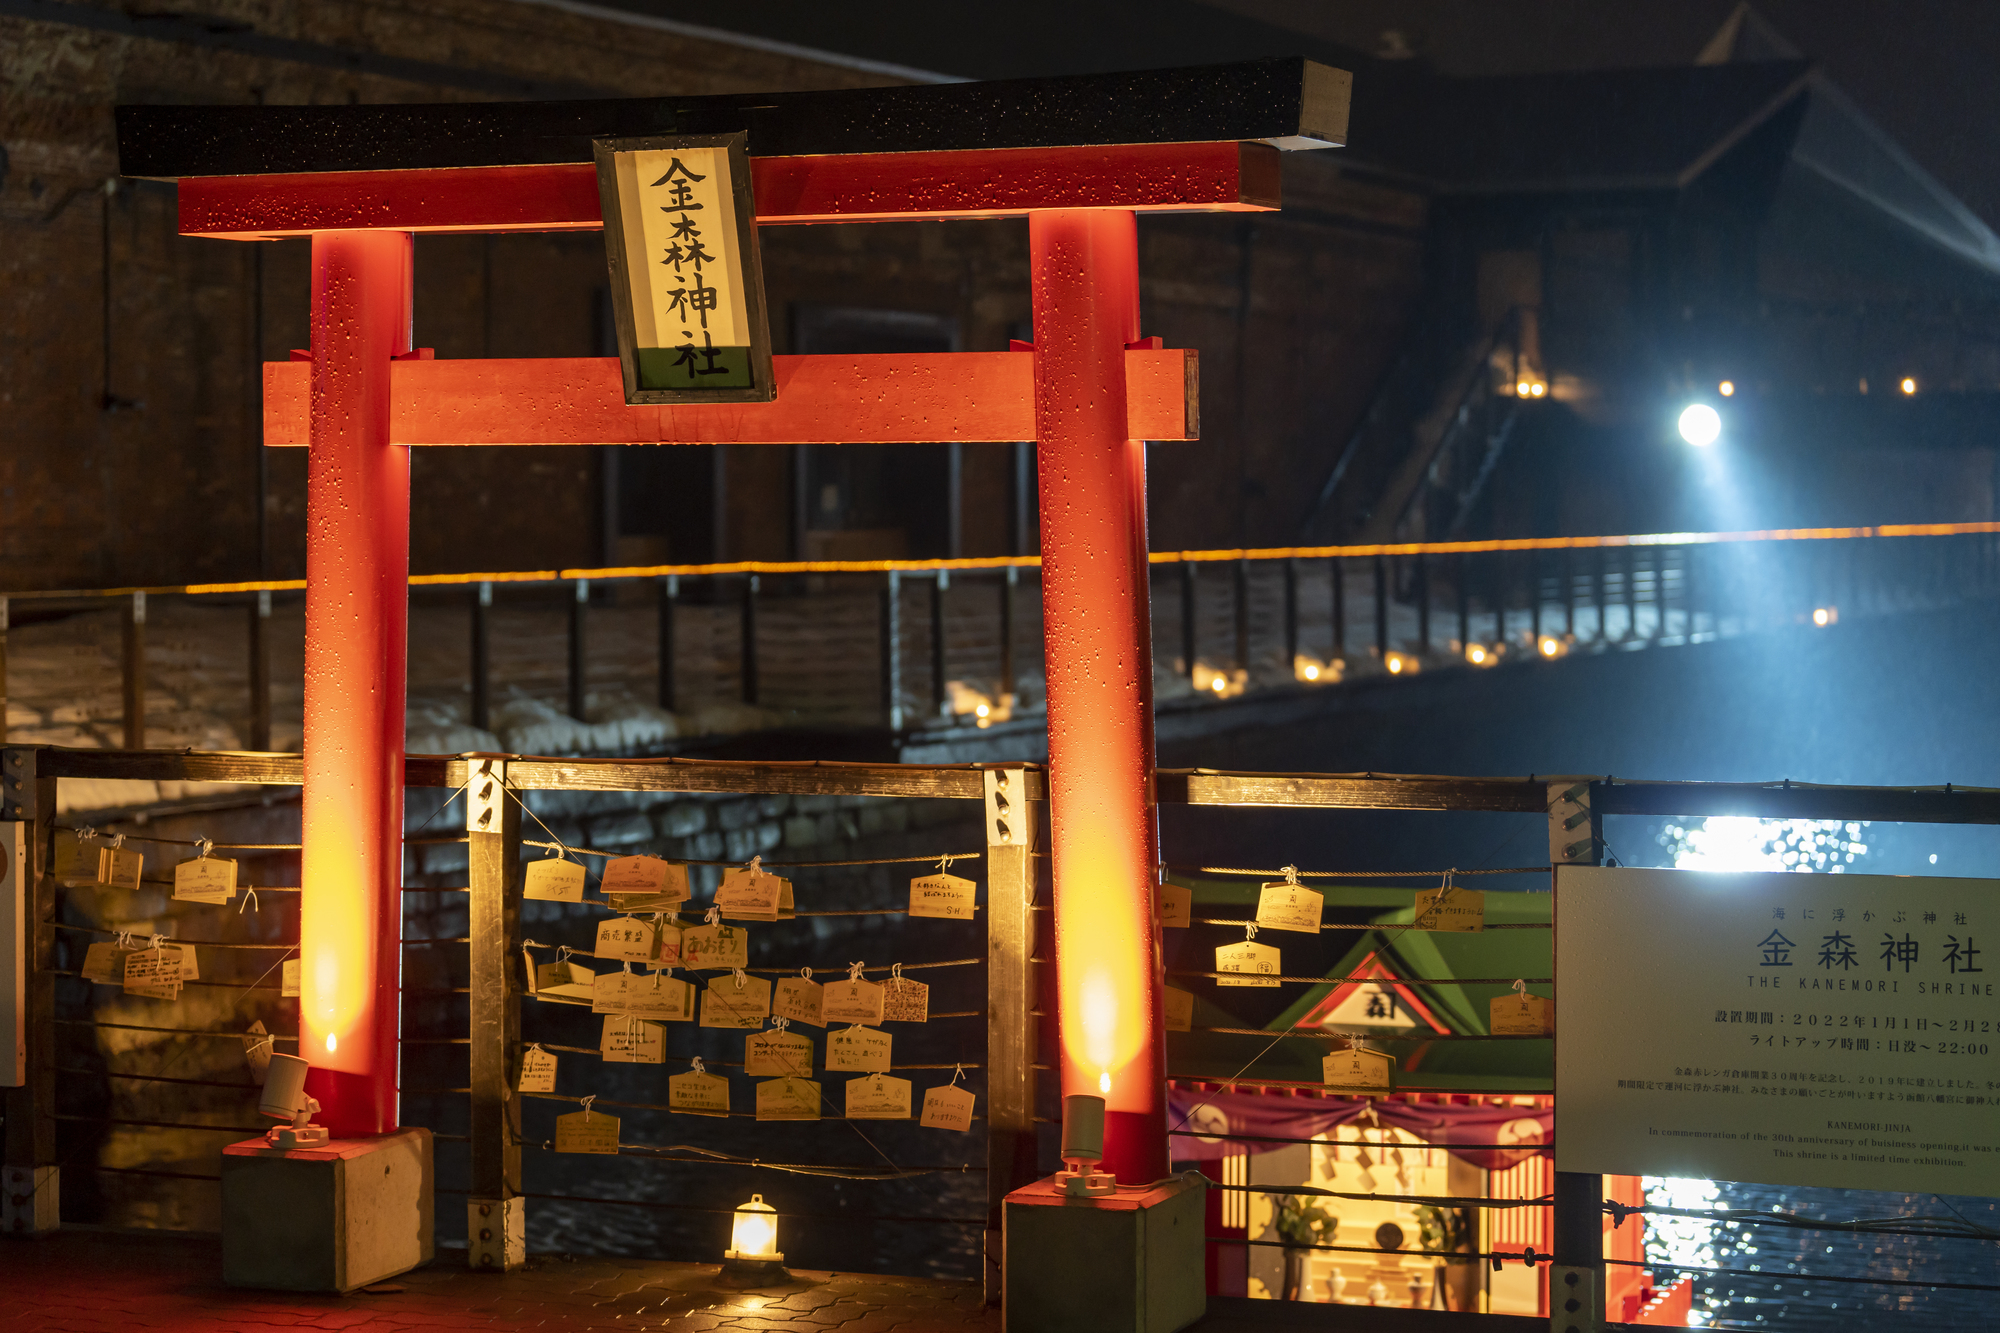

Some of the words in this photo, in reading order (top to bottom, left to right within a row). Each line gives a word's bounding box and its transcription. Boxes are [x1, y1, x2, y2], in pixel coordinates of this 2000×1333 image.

[650, 157, 730, 379] 金森神社
[1772, 907, 1968, 925] 海に浮かぶ神社
[1756, 928, 1984, 975] 金森神社
[1747, 976, 1782, 989] THE
[1799, 978, 1899, 993] KANEMORI
[1918, 982, 1994, 996] SHRINE
[1827, 1120, 1912, 1133] KANEMORI-JINJA
[1648, 1127, 1659, 1136] In
[1661, 1129, 1737, 1140] commemoration
[1740, 1132, 1750, 1140] of
[1753, 1132, 1769, 1141] the
[1771, 1133, 1795, 1143] 30th
[1797, 1136, 1855, 1147] anniversary
[1858, 1138, 1868, 1147] of
[1973, 1145, 1992, 1153] was
[1772, 1149, 1794, 1158] This
[1797, 1150, 1827, 1160] shrine
[1830, 1152, 1839, 1161] is
[1851, 1153, 1885, 1163] limited
[1888, 1155, 1910, 1164] time
[1913, 1156, 1967, 1167] exhibition.
